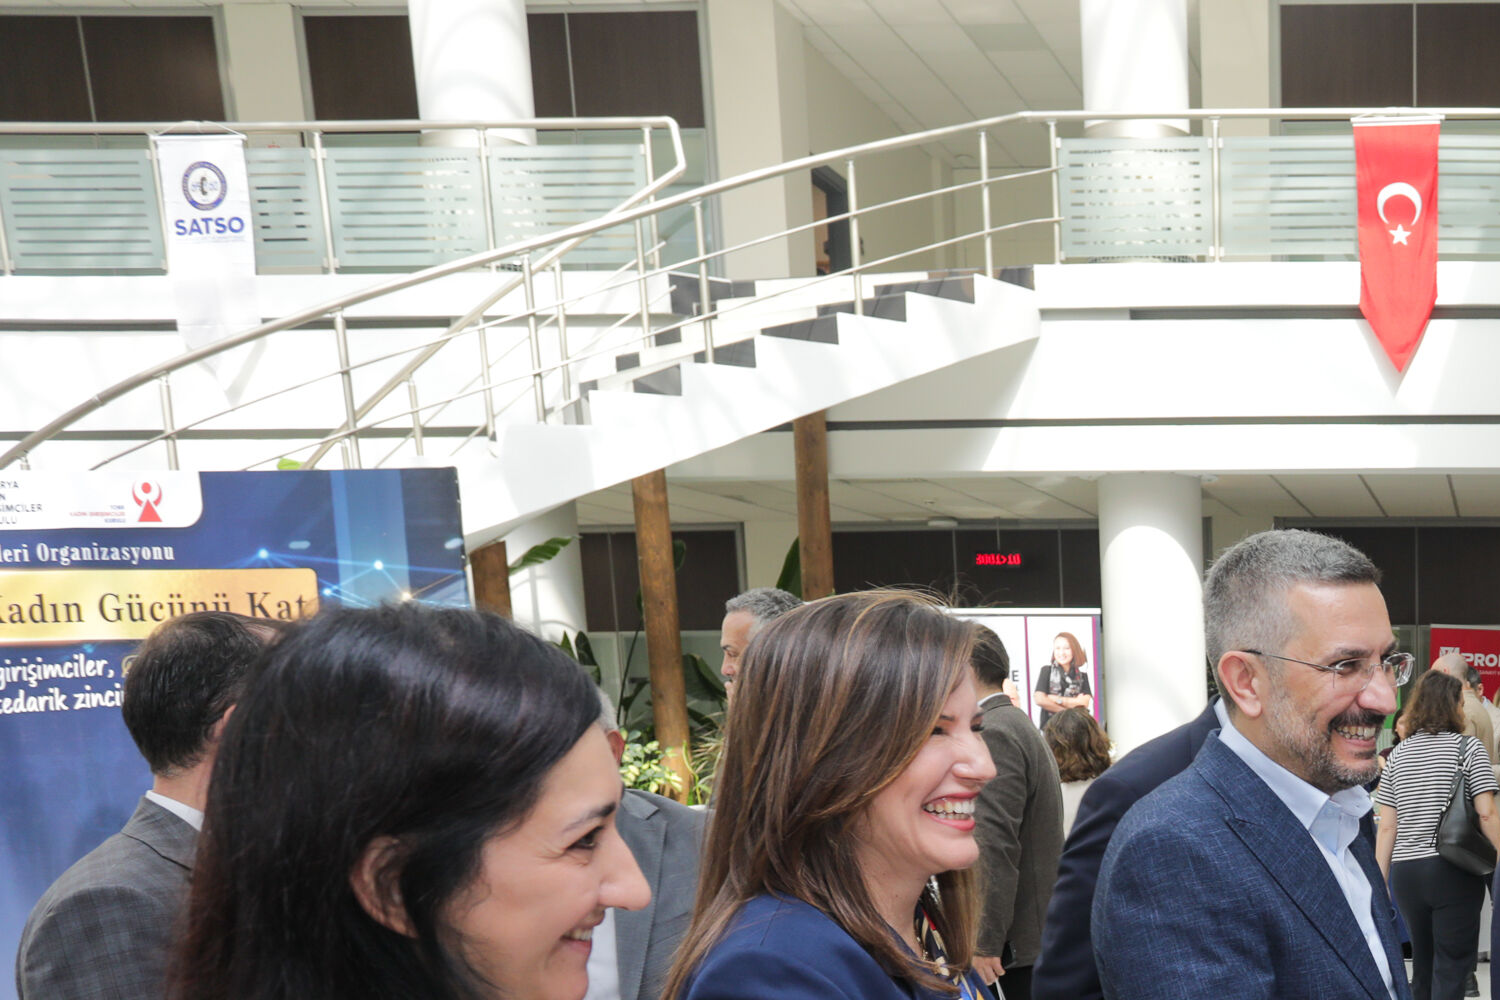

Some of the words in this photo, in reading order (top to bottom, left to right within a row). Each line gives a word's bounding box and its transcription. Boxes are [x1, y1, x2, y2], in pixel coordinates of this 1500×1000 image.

[175, 217, 244, 236] SATSO
[36, 541, 175, 565] Organizasyonu
[98, 592, 231, 623] Gücünü
[0, 687, 69, 714] edarik
